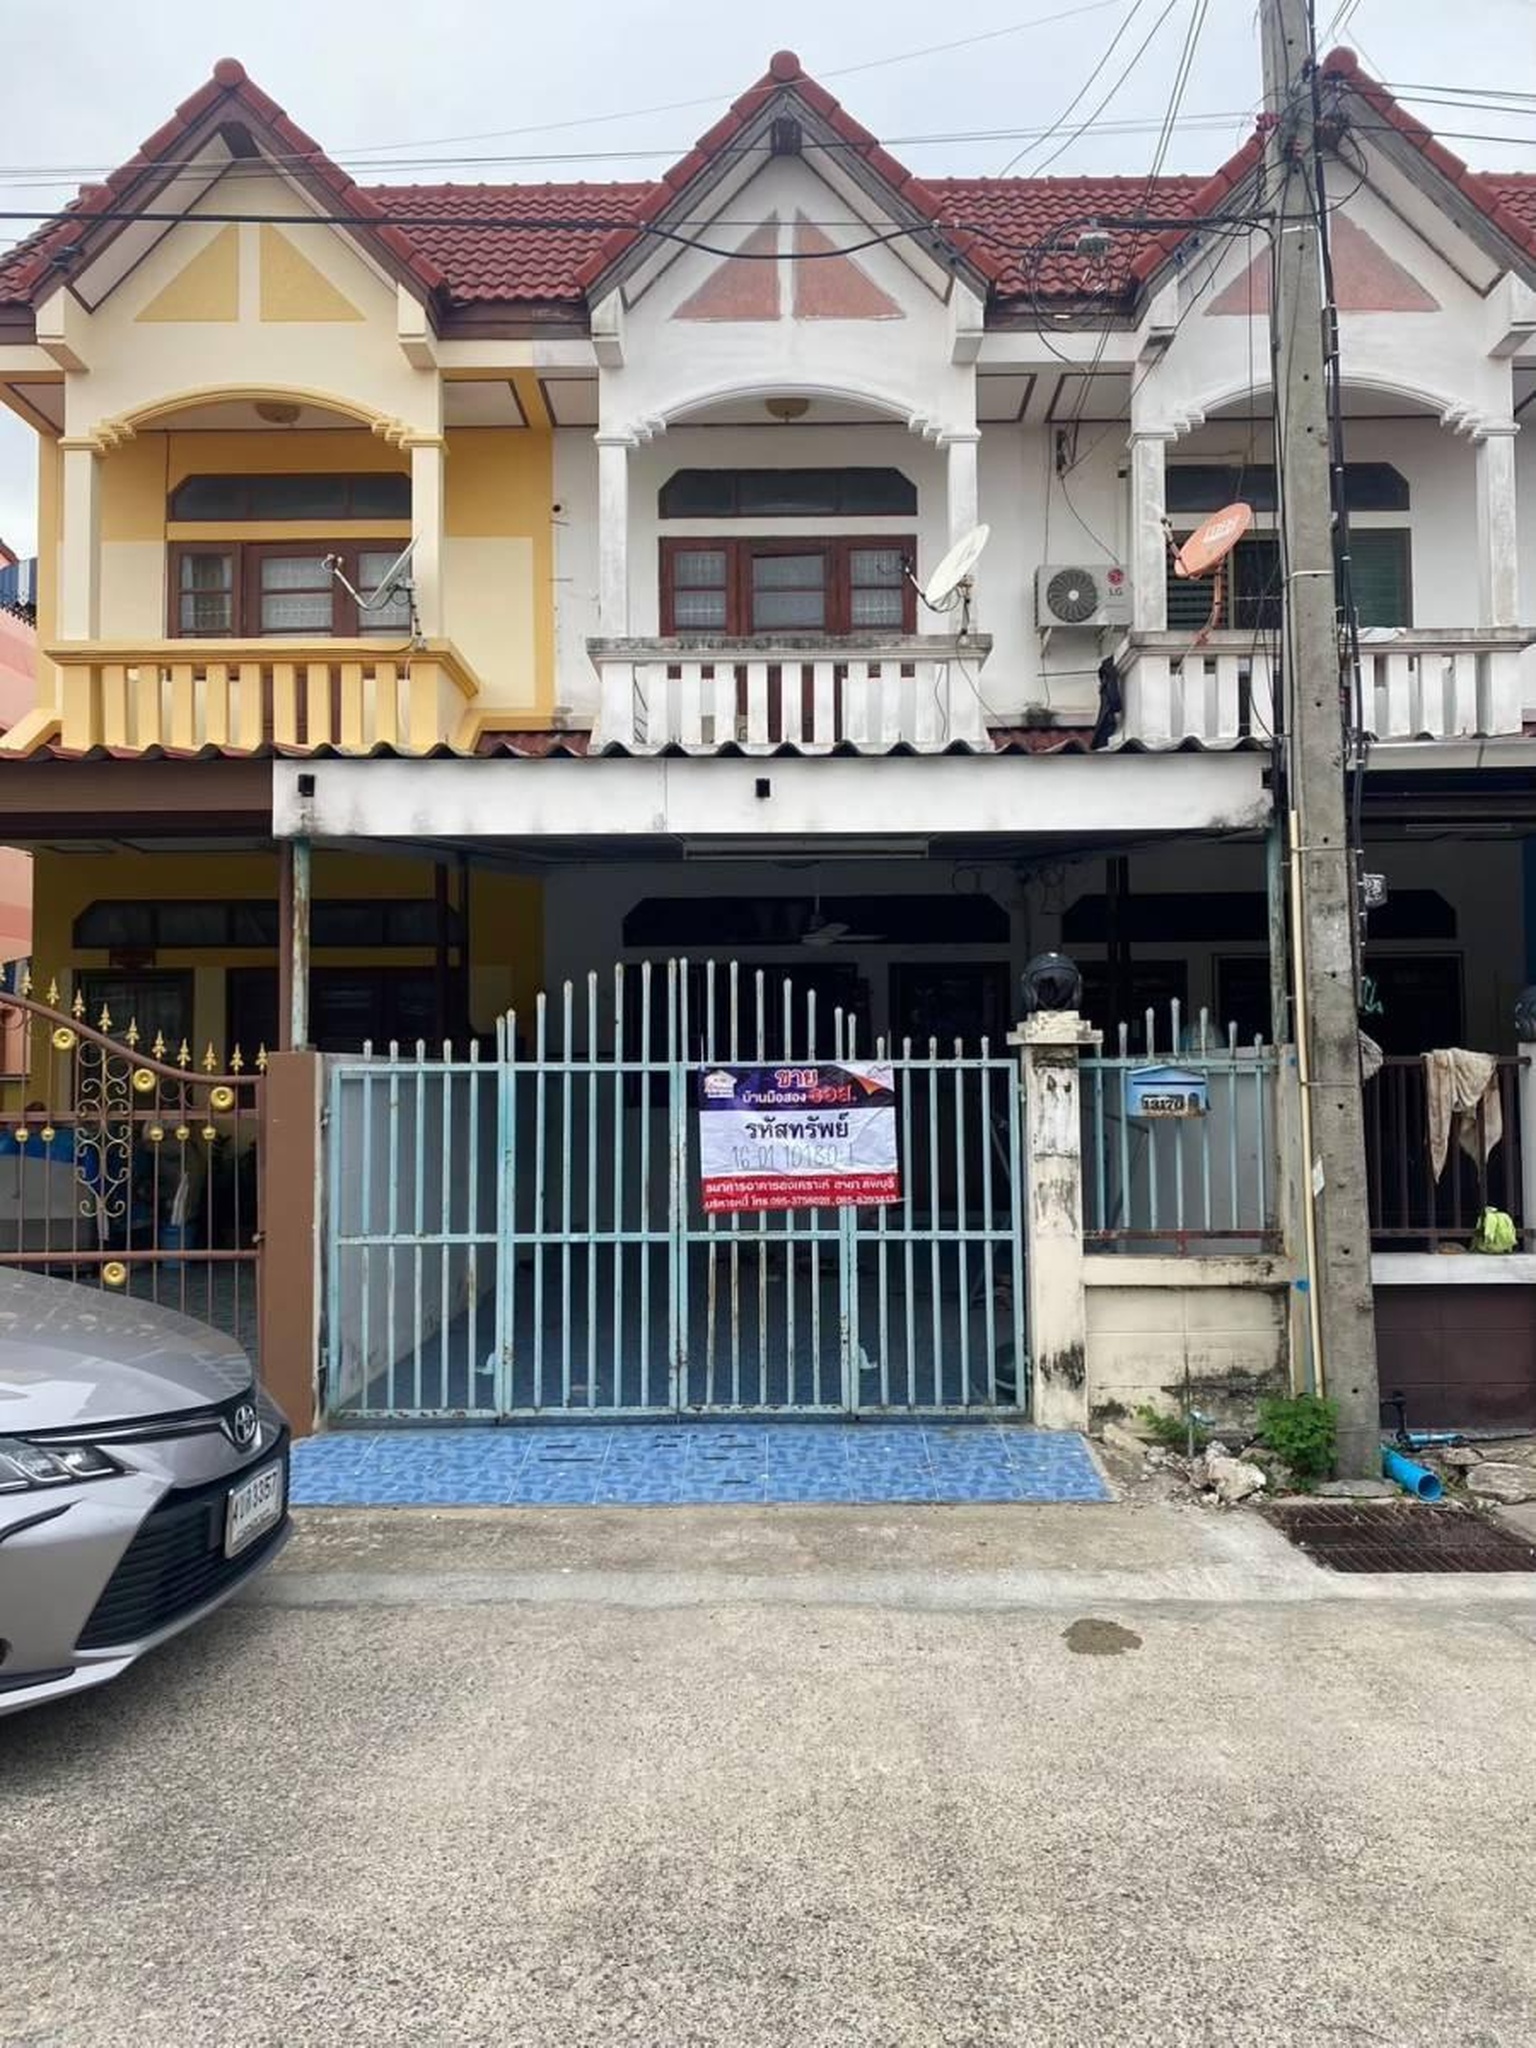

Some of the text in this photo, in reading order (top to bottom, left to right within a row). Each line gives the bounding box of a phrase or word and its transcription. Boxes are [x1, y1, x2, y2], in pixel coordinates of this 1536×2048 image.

[1109, 588, 1123, 597] LG
[774, 1068, 818, 1088] ขาย
[742, 1090, 807, 1104] บ้านมือสอง
[745, 1112, 849, 1139] รหัสทรัพย์
